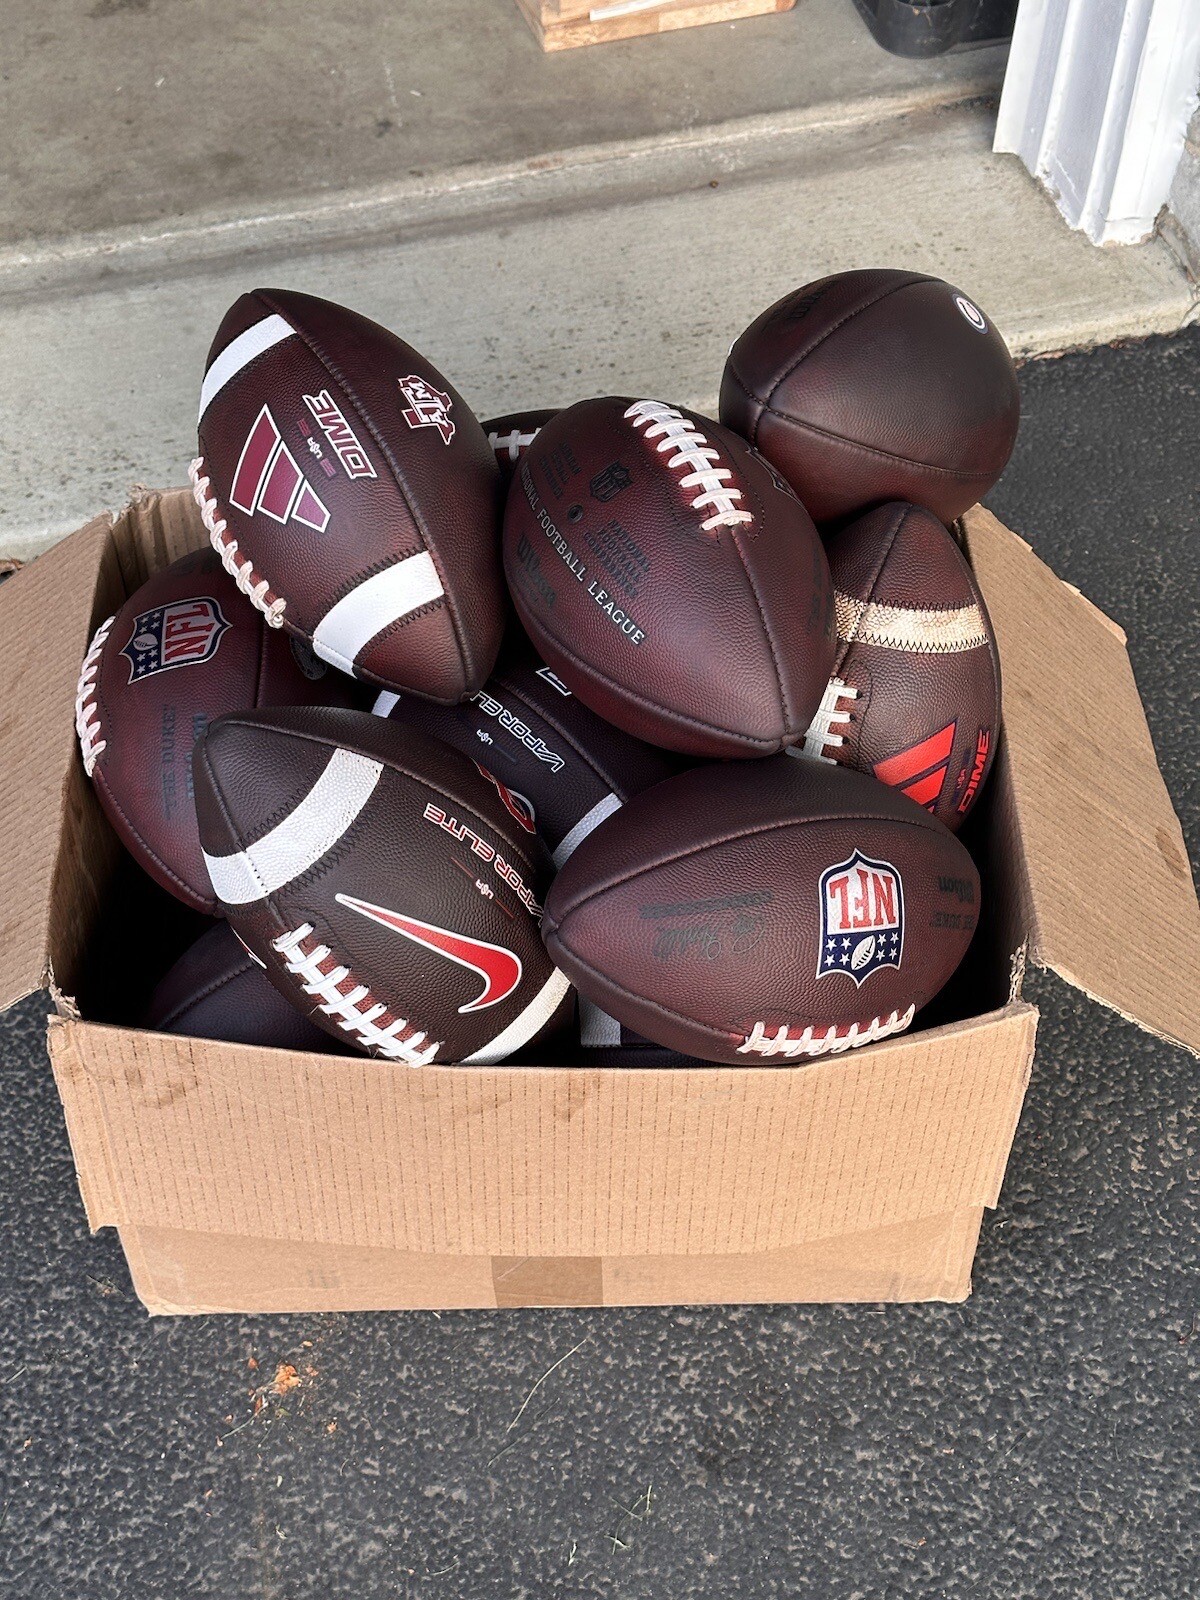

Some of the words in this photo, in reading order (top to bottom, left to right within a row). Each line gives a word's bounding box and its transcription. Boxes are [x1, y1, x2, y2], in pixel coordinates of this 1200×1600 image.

[302, 389, 377, 480] DIME
[537, 511, 585, 582] FOOTBALL
[588, 581, 645, 645] LEAGUE
[164, 603, 210, 663] NFL
[499, 708, 565, 773] VAPOR
[958, 729, 990, 813] DIME
[423, 803, 496, 863] ELITE
[829, 868, 898, 931] NFL
